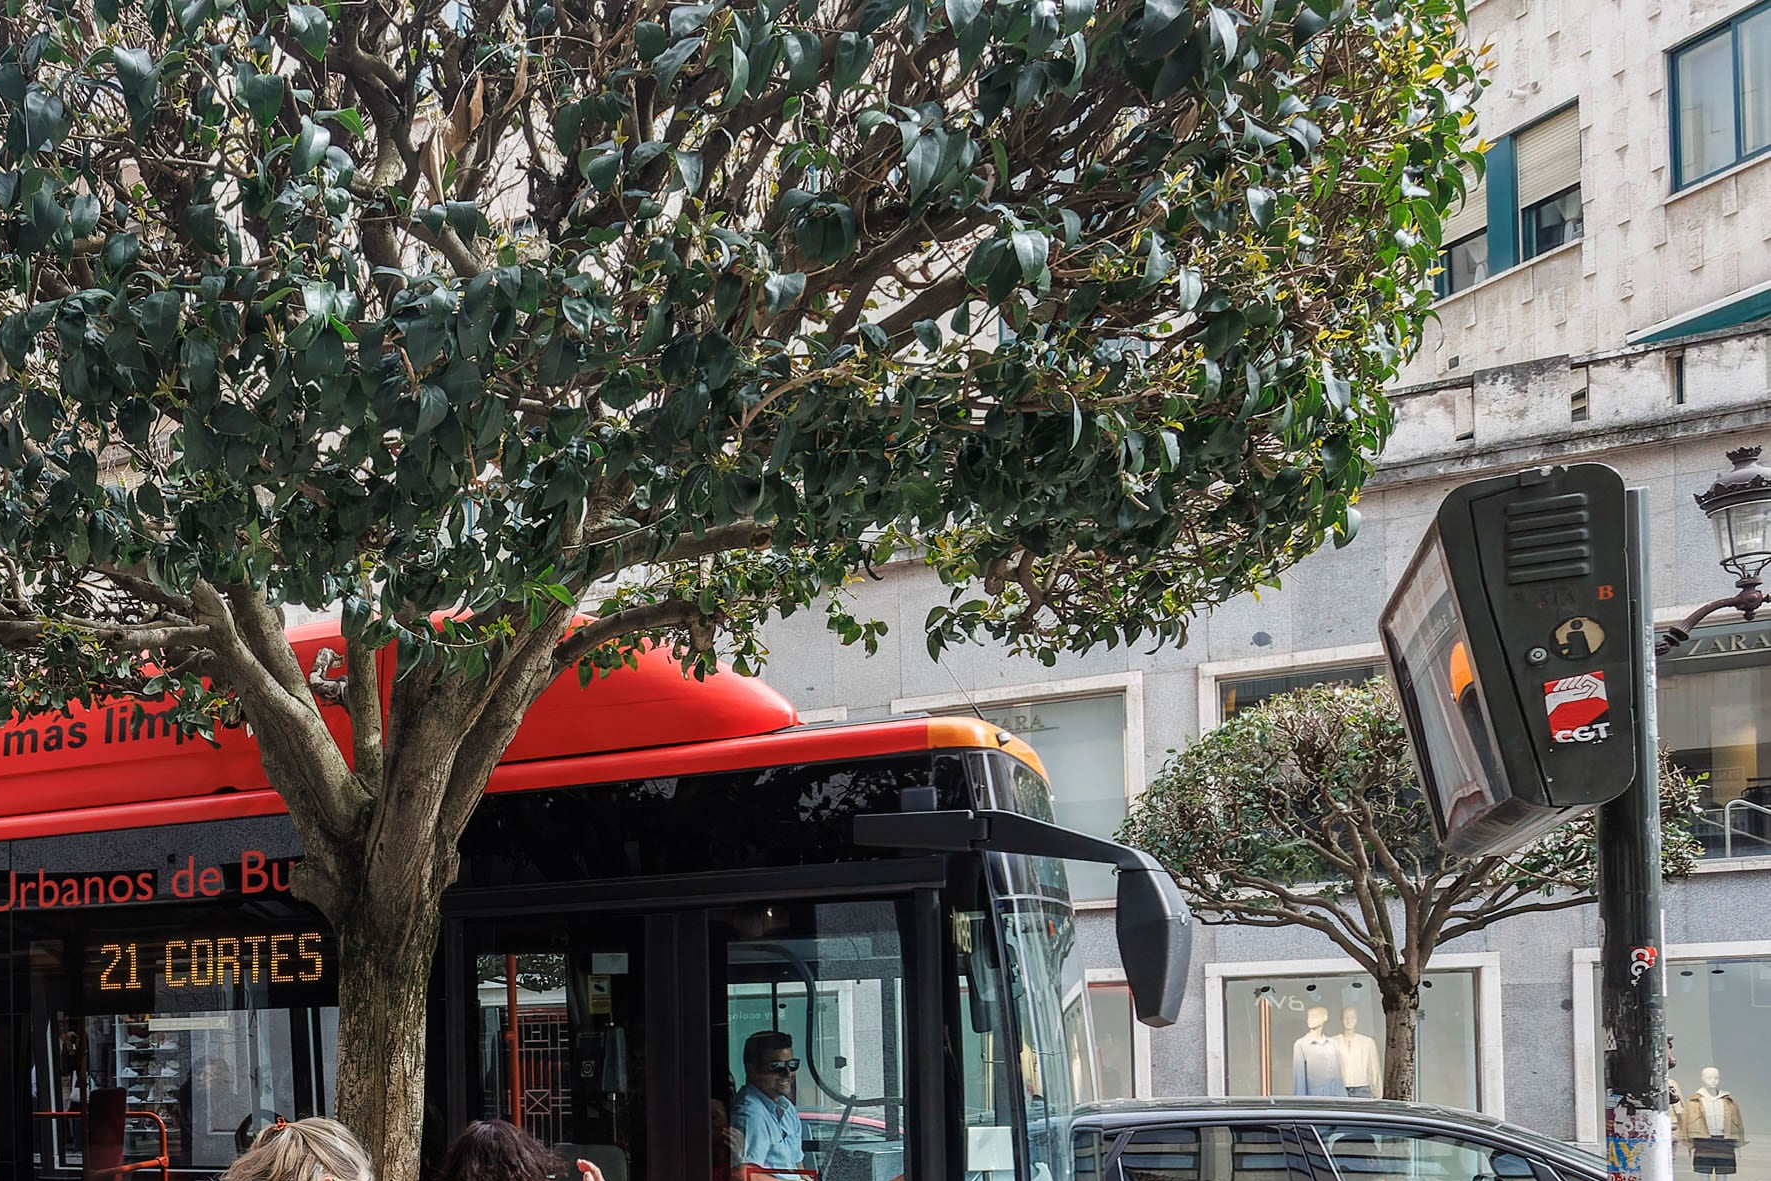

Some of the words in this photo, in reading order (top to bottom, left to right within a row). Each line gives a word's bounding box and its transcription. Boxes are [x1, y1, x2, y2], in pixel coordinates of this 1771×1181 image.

[1597, 584, 1614, 601] B
[1688, 633, 1771, 656] ZARA
[3, 713, 88, 757] más
[1555, 721, 1611, 744] CGT
[171, 855, 223, 899] de
[99, 942, 142, 991] 21
[164, 931, 324, 988] CORTES
